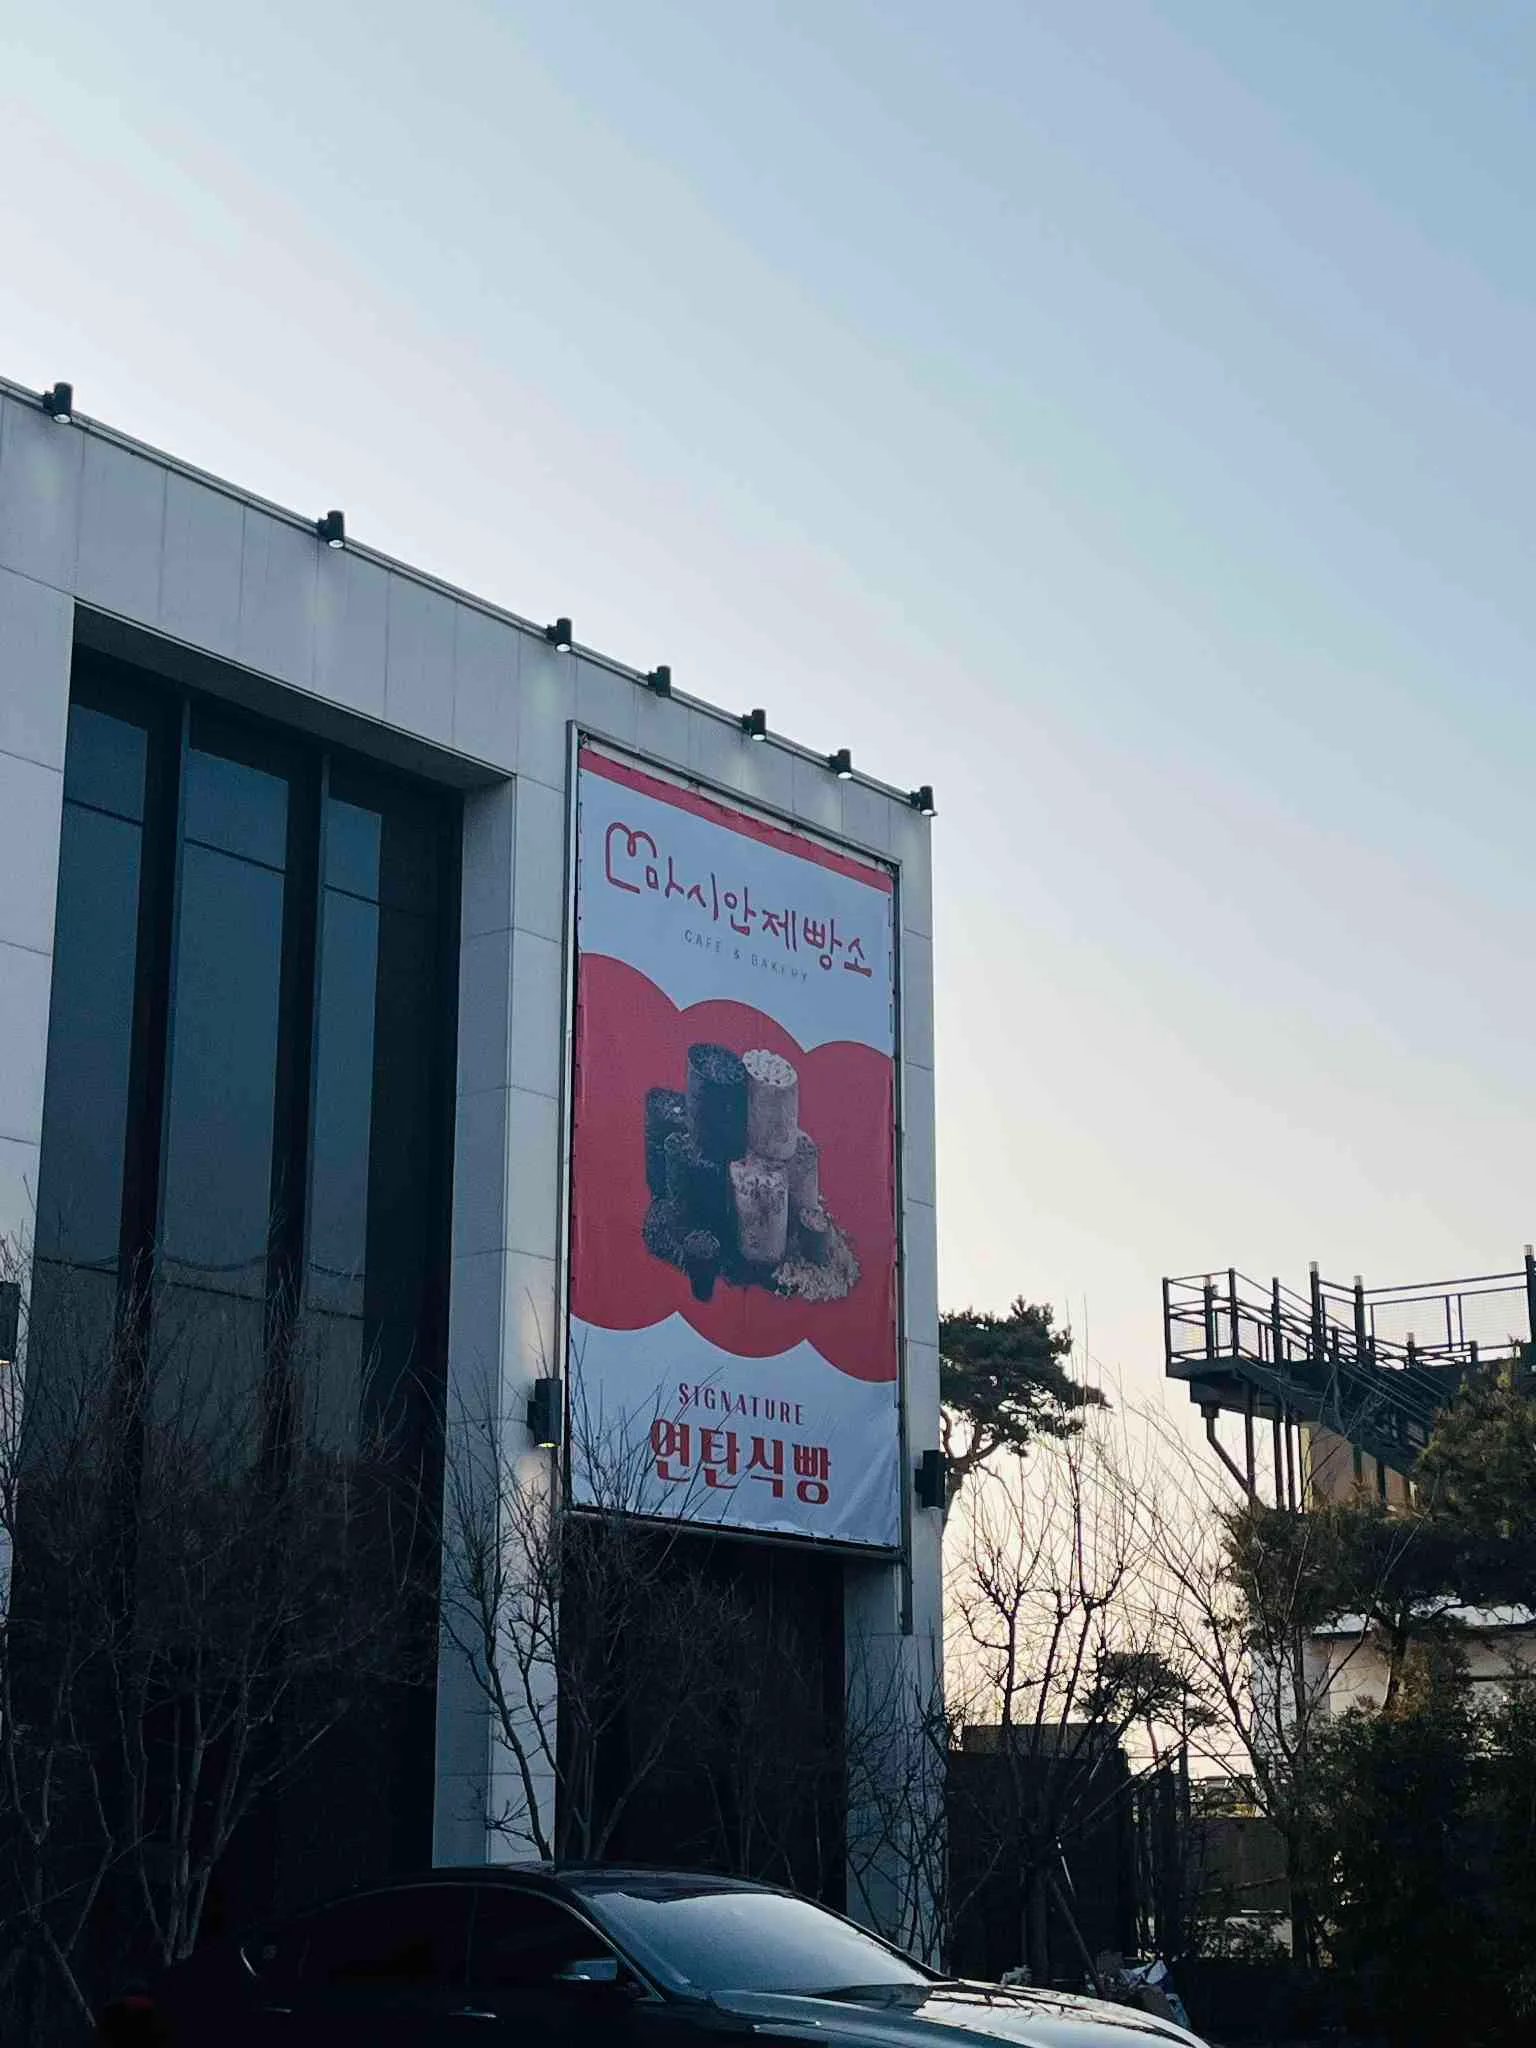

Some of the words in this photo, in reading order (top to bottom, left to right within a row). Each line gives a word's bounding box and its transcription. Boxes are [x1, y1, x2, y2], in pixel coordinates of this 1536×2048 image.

[606, 822, 873, 978] 마시안제빵소
[684, 929, 722, 953] CAFE
[733, 949, 741, 960] &
[679, 1383, 804, 1425] SIGNATURE
[650, 1418, 832, 1505] 연탄식빵
